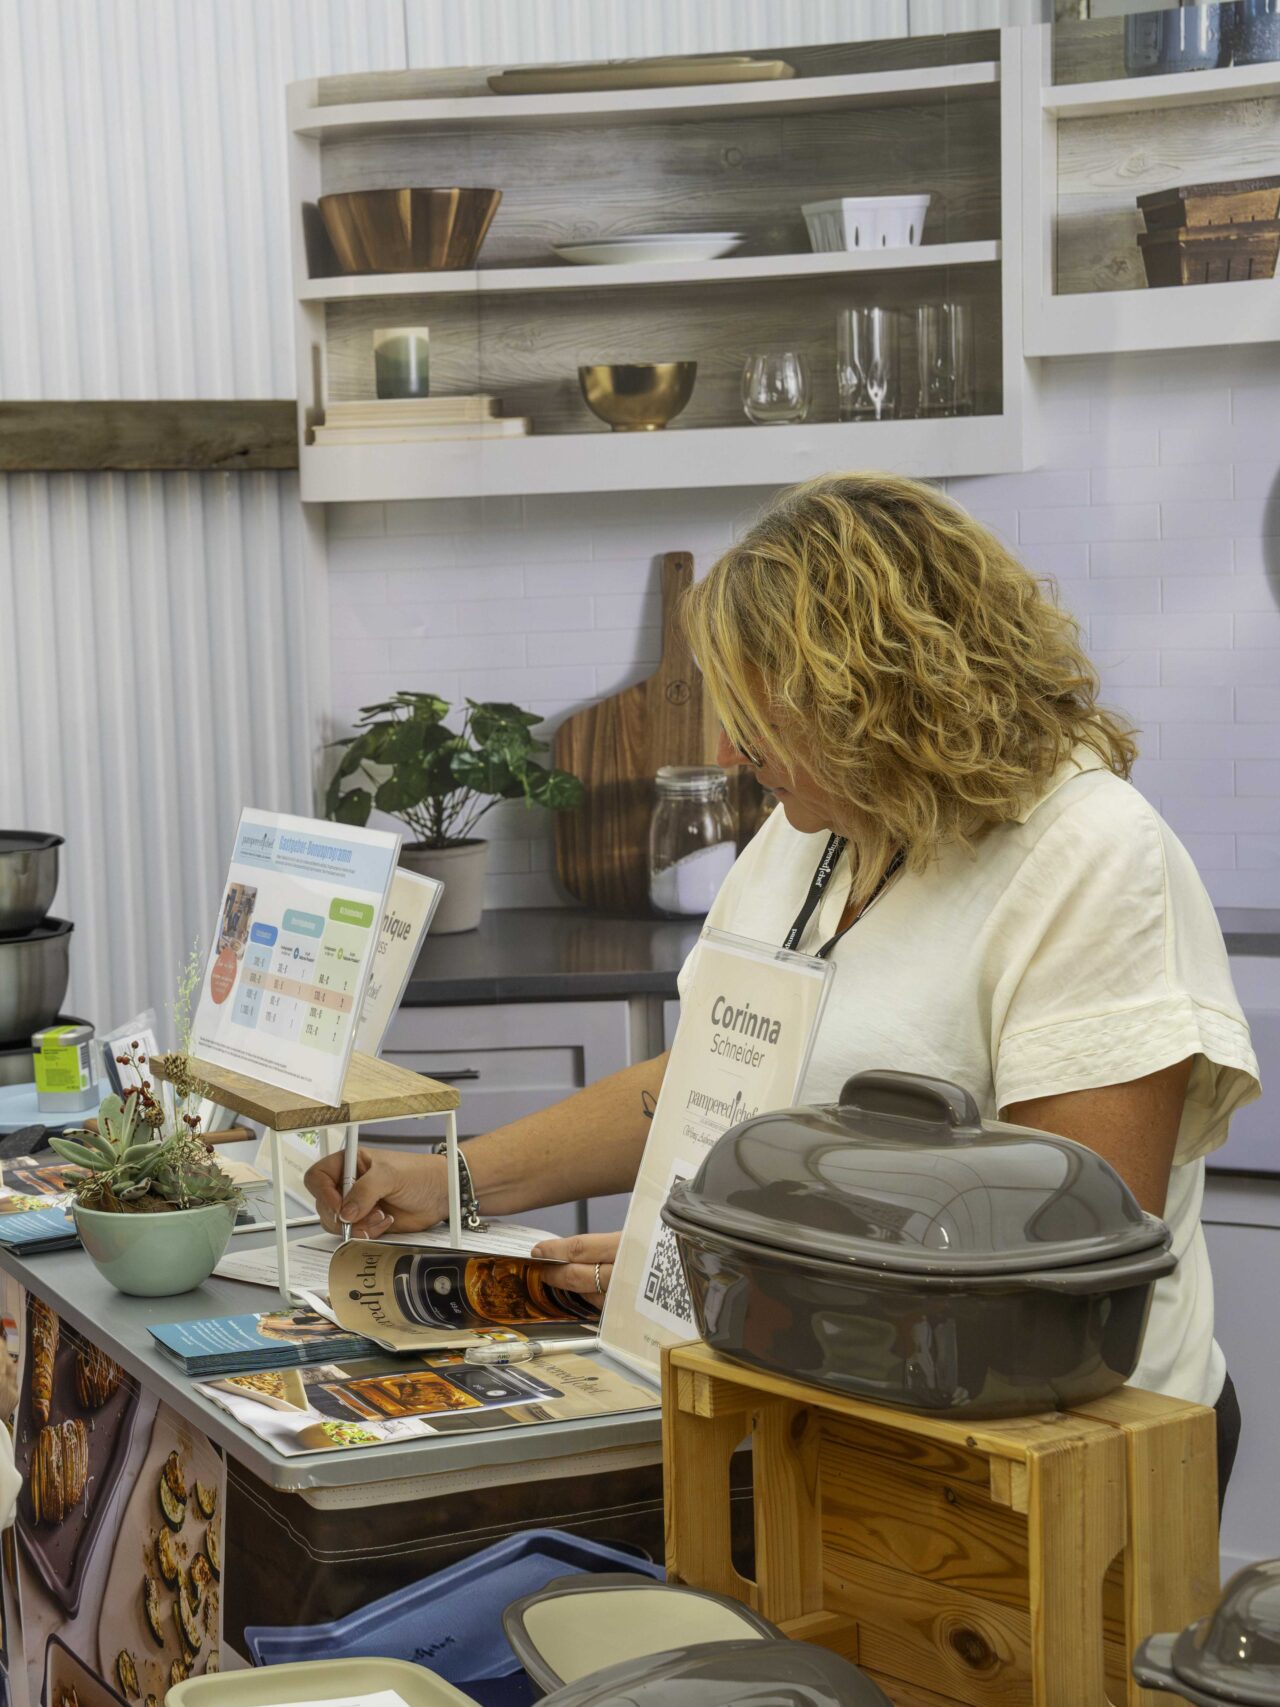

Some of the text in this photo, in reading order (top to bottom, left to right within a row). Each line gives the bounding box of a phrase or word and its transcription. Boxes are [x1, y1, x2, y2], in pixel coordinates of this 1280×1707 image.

[711, 995, 782, 1045] Corinna
[710, 1033, 766, 1068] Schneider
[686, 1089, 735, 1119] pampered
